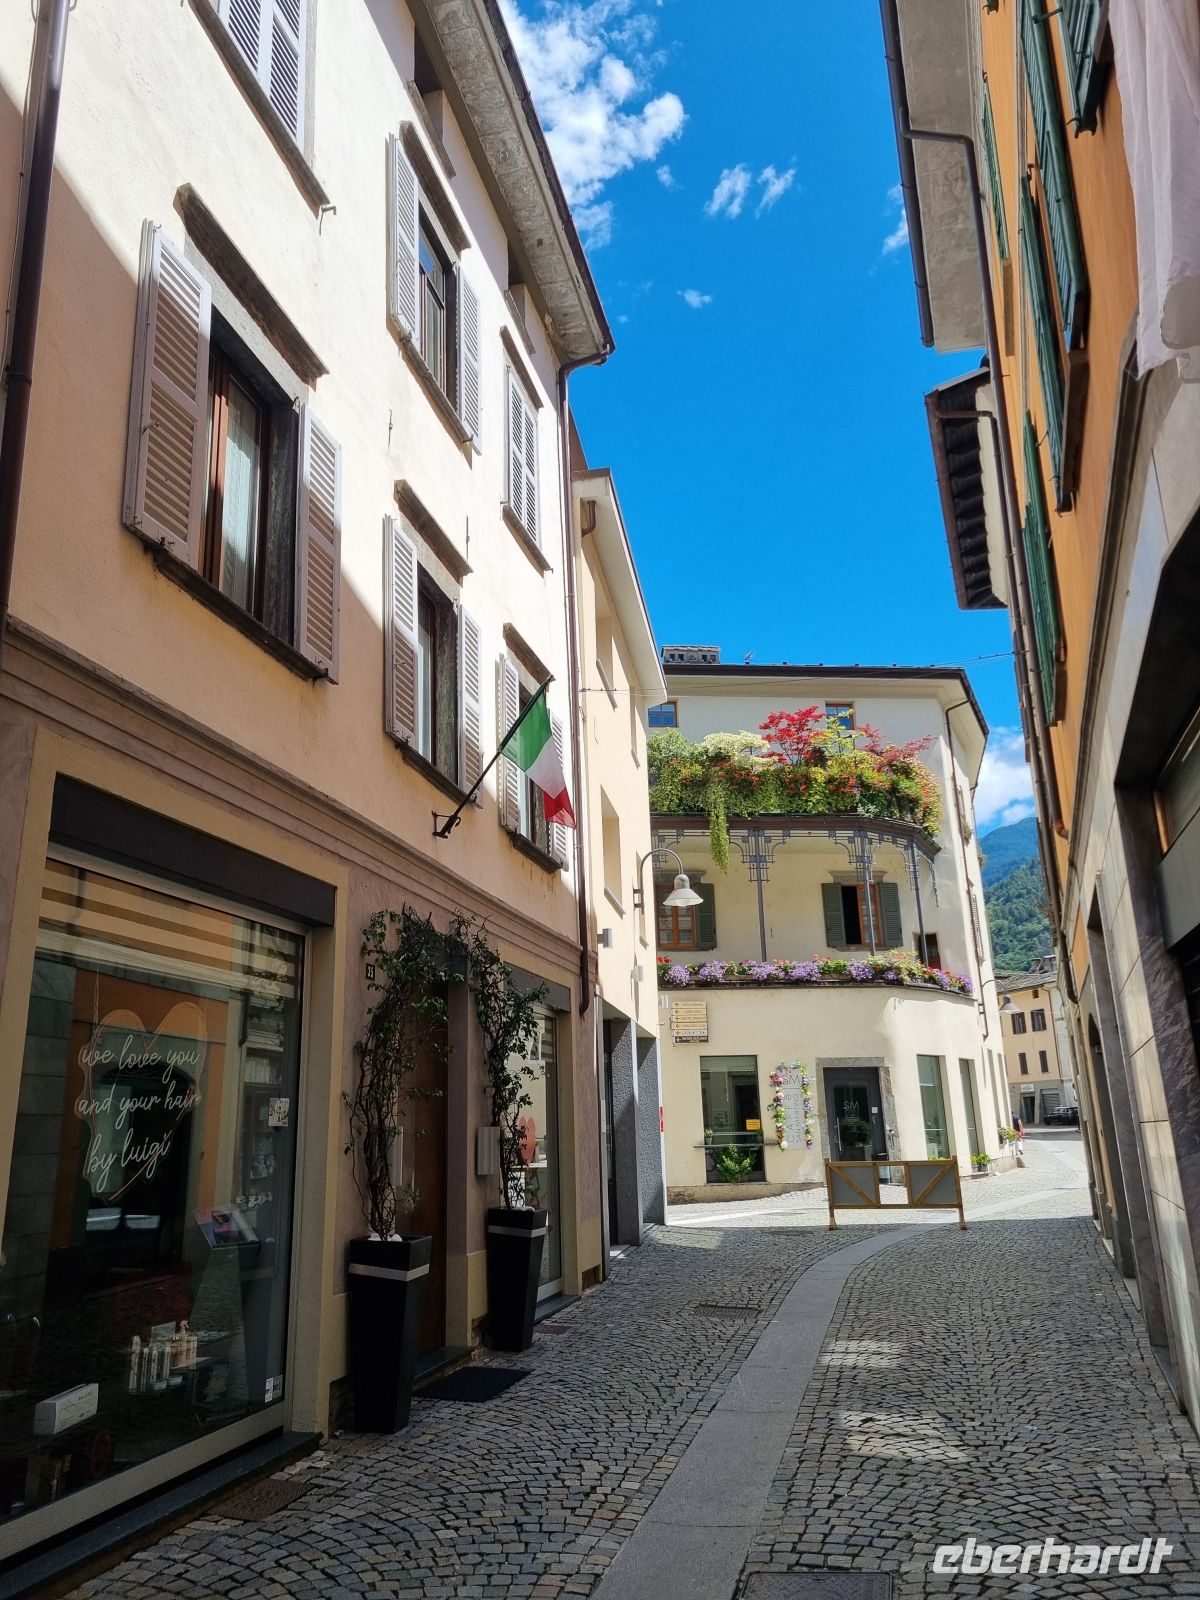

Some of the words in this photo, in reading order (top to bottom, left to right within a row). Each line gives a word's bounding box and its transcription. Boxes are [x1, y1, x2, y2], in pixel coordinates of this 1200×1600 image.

[82, 1048, 115, 1067] we
[118, 1034, 162, 1070] love
[162, 1049, 200, 1084] you
[78, 1082, 116, 1116] and
[115, 1094, 162, 1130] your
[164, 1080, 201, 1111] hair
[87, 1133, 118, 1193] by
[121, 1127, 172, 1179] luigi
